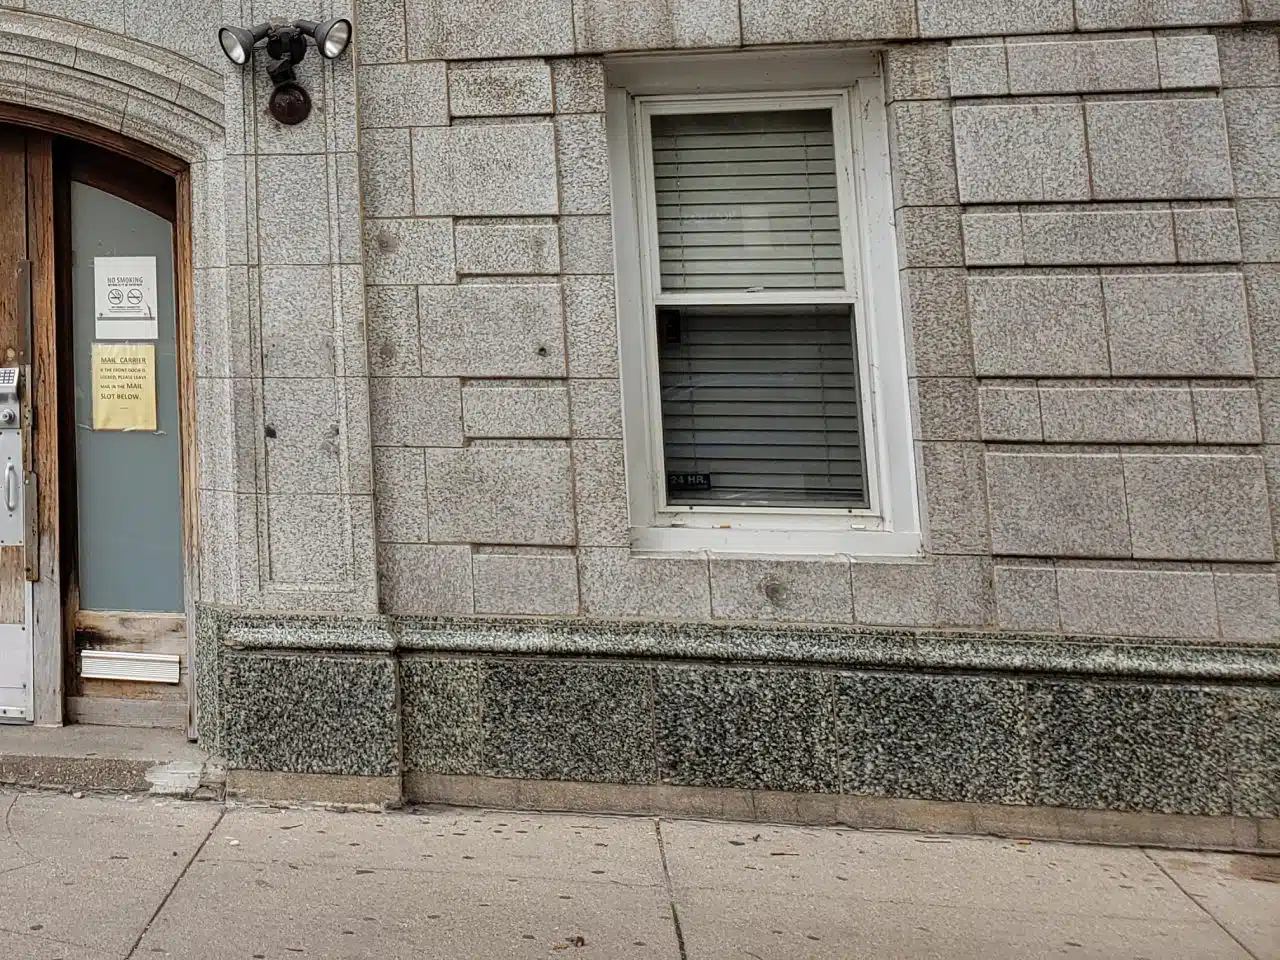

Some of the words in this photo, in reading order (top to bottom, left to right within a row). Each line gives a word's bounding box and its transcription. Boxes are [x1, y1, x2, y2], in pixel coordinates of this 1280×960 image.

[107, 276, 116, 284] NO
[116, 276, 144, 284] SMOKING
[100, 356, 117, 364] MAIL
[119, 356, 147, 364] CARRIER
[116, 393, 142, 401] BELOW.
[670, 475, 685, 484] 24
